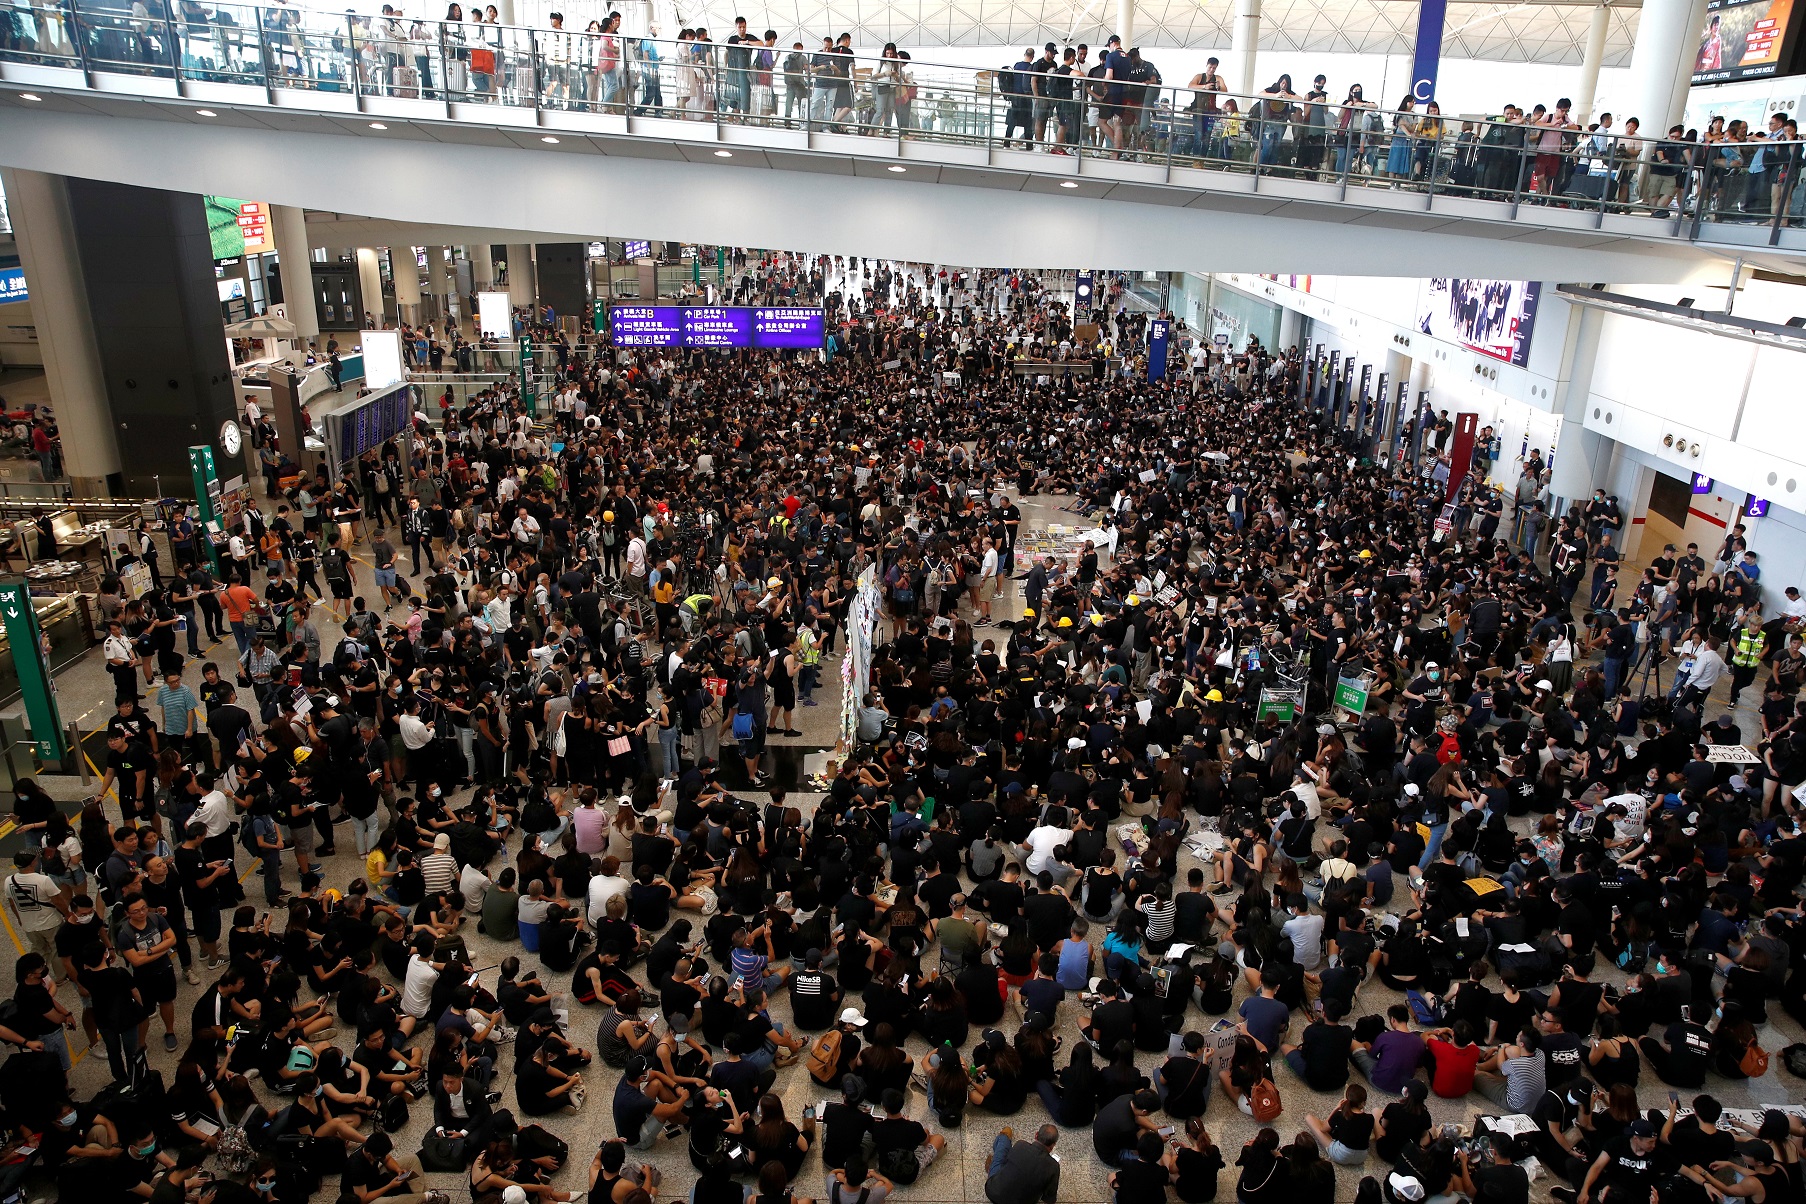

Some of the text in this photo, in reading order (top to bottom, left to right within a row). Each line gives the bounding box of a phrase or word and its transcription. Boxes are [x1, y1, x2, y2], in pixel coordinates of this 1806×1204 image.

[1413, 79, 1432, 101] C
[647, 309, 654, 319] B
[721, 310, 727, 319] 1
[1618, 1156, 1648, 1170] SEOUL
